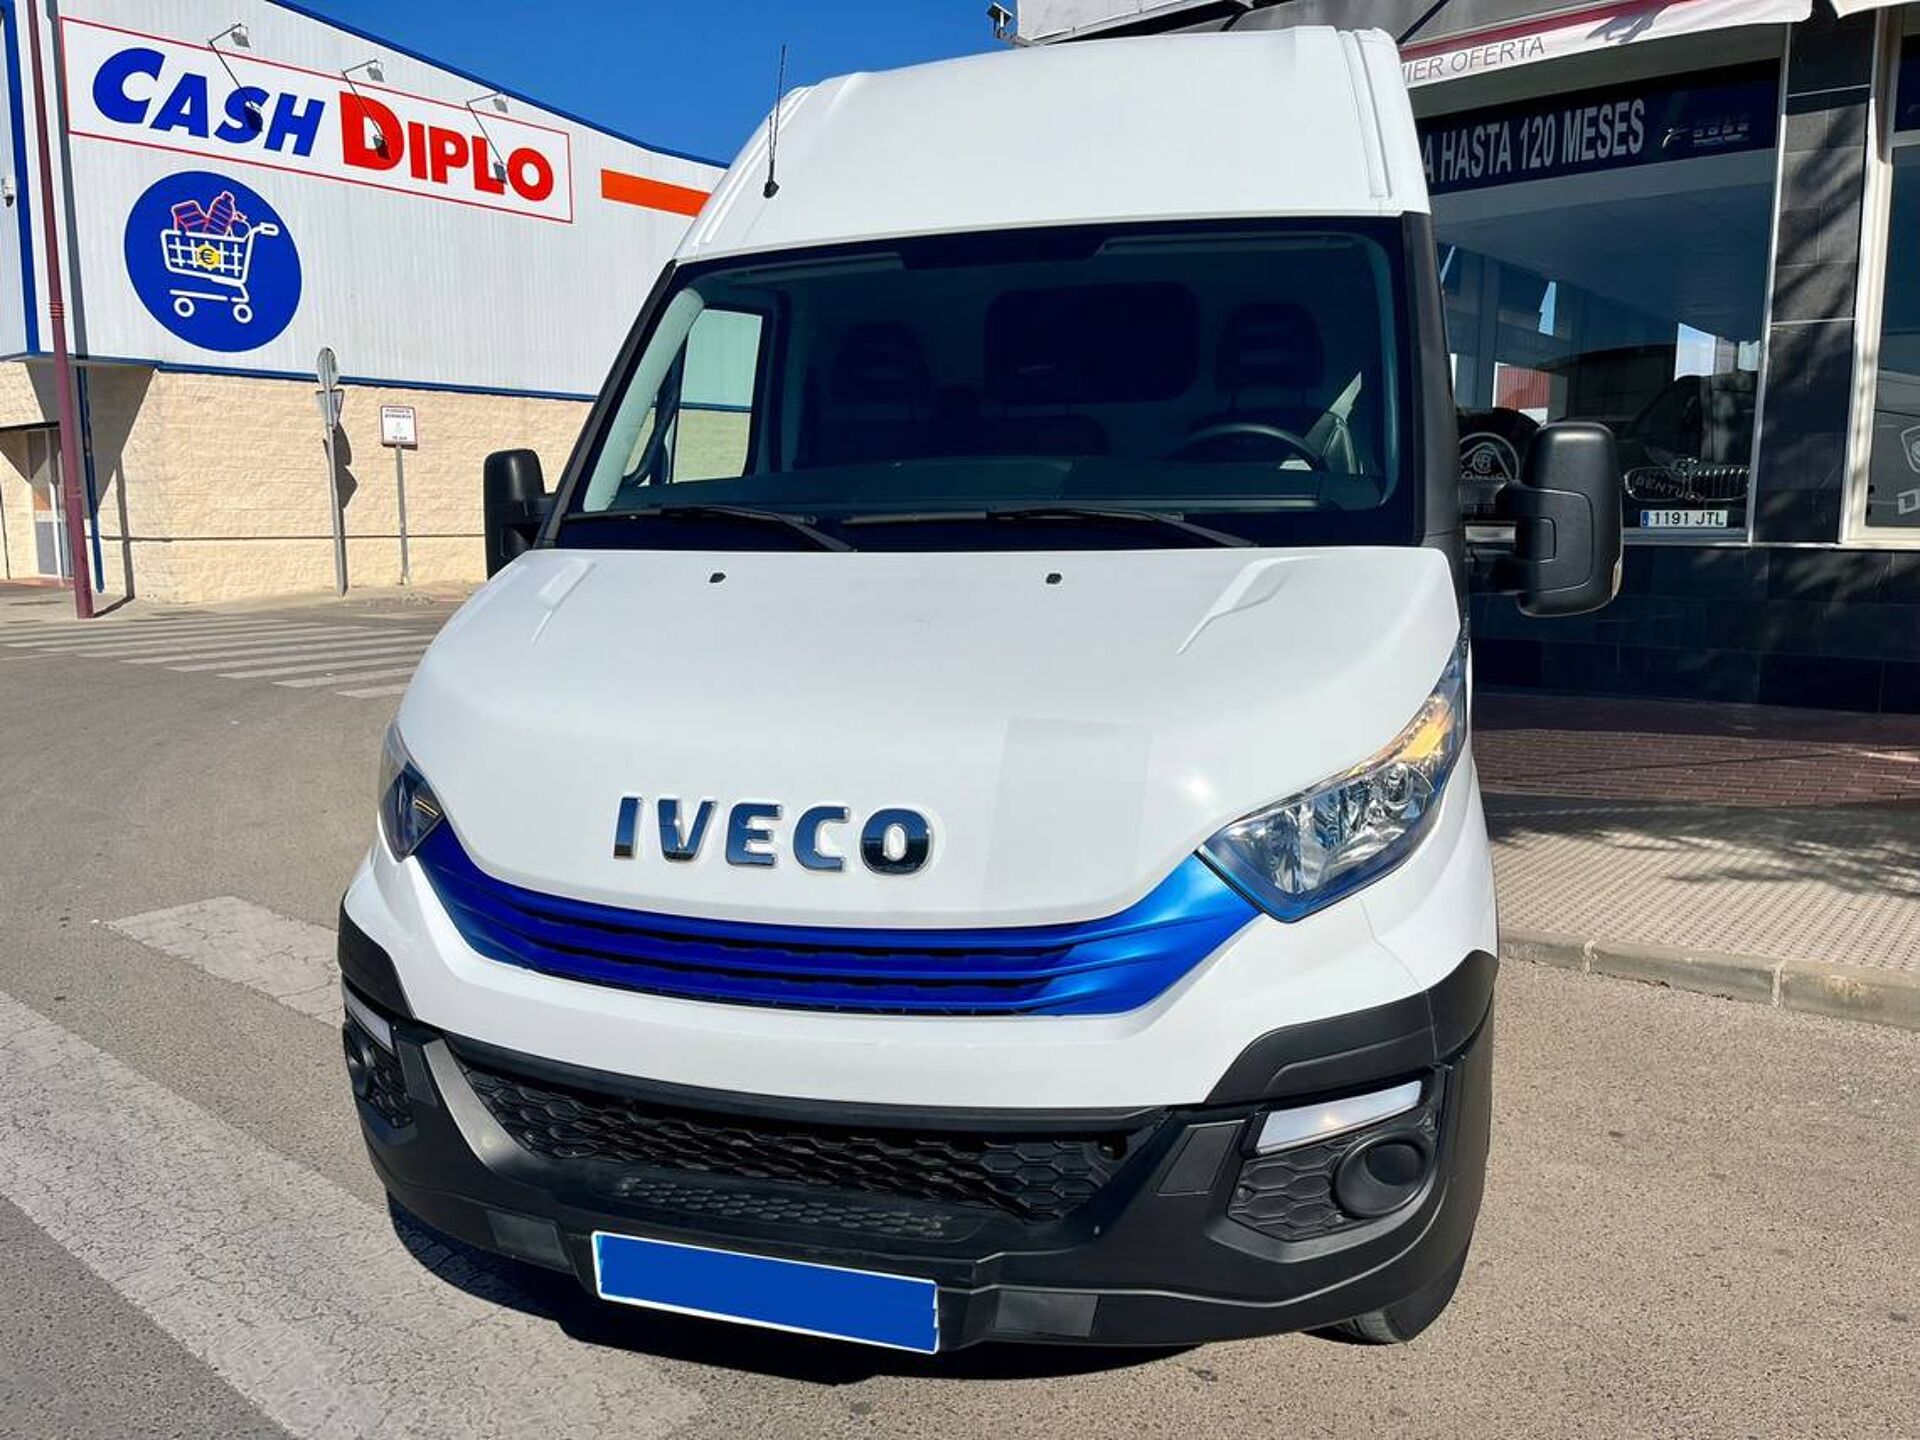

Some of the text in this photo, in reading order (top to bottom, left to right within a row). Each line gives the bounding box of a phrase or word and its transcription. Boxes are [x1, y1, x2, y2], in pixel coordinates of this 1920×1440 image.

[1451, 37, 1545, 72] OFERTA
[92, 47, 554, 201] CASH DIPLO
[1441, 121, 1512, 182] HASTA
[1520, 113, 1555, 170] 120
[1562, 98, 1645, 164] MESES
[1654, 511, 1724, 526] 1191 JTL
[613, 796, 935, 876] IVECO
